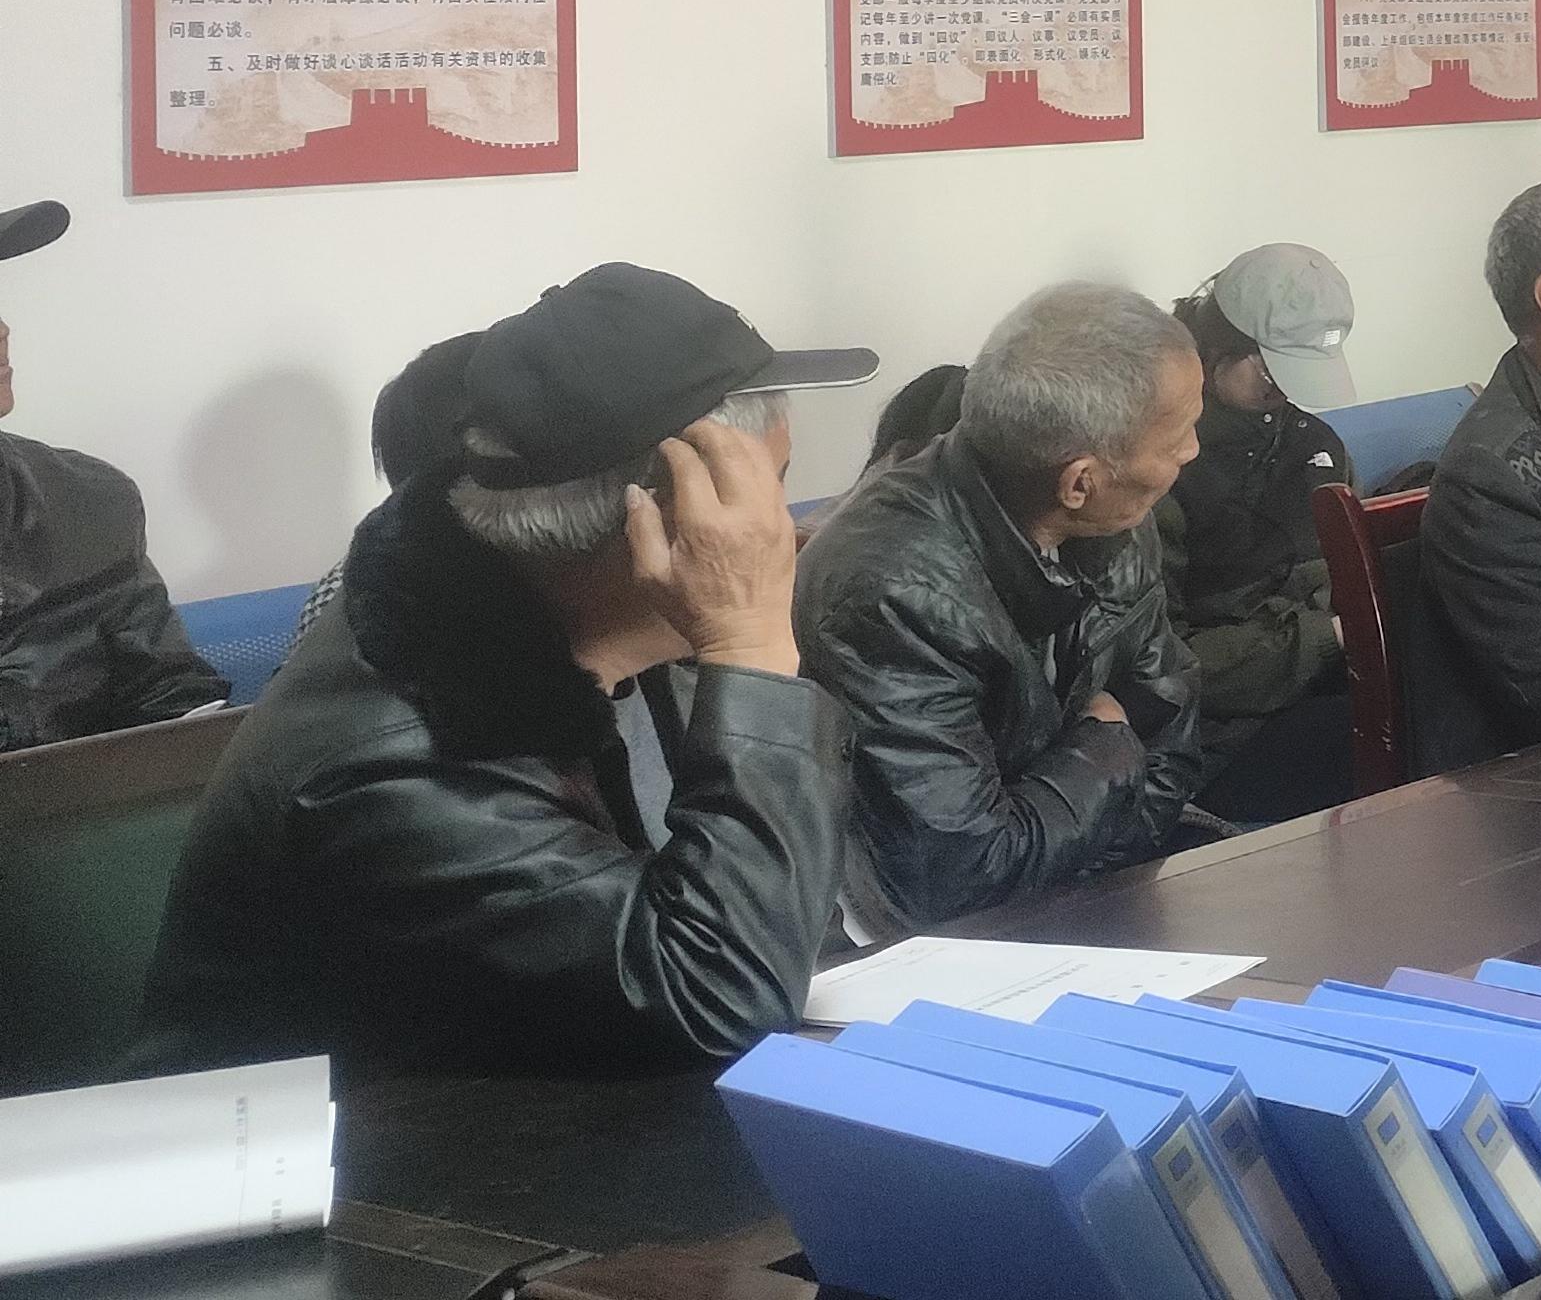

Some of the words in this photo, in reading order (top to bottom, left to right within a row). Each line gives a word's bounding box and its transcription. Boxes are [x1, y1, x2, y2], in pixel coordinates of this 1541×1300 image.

[207, 51, 546, 71] 五、及时做好谈心谈话活动有关资料的收集
